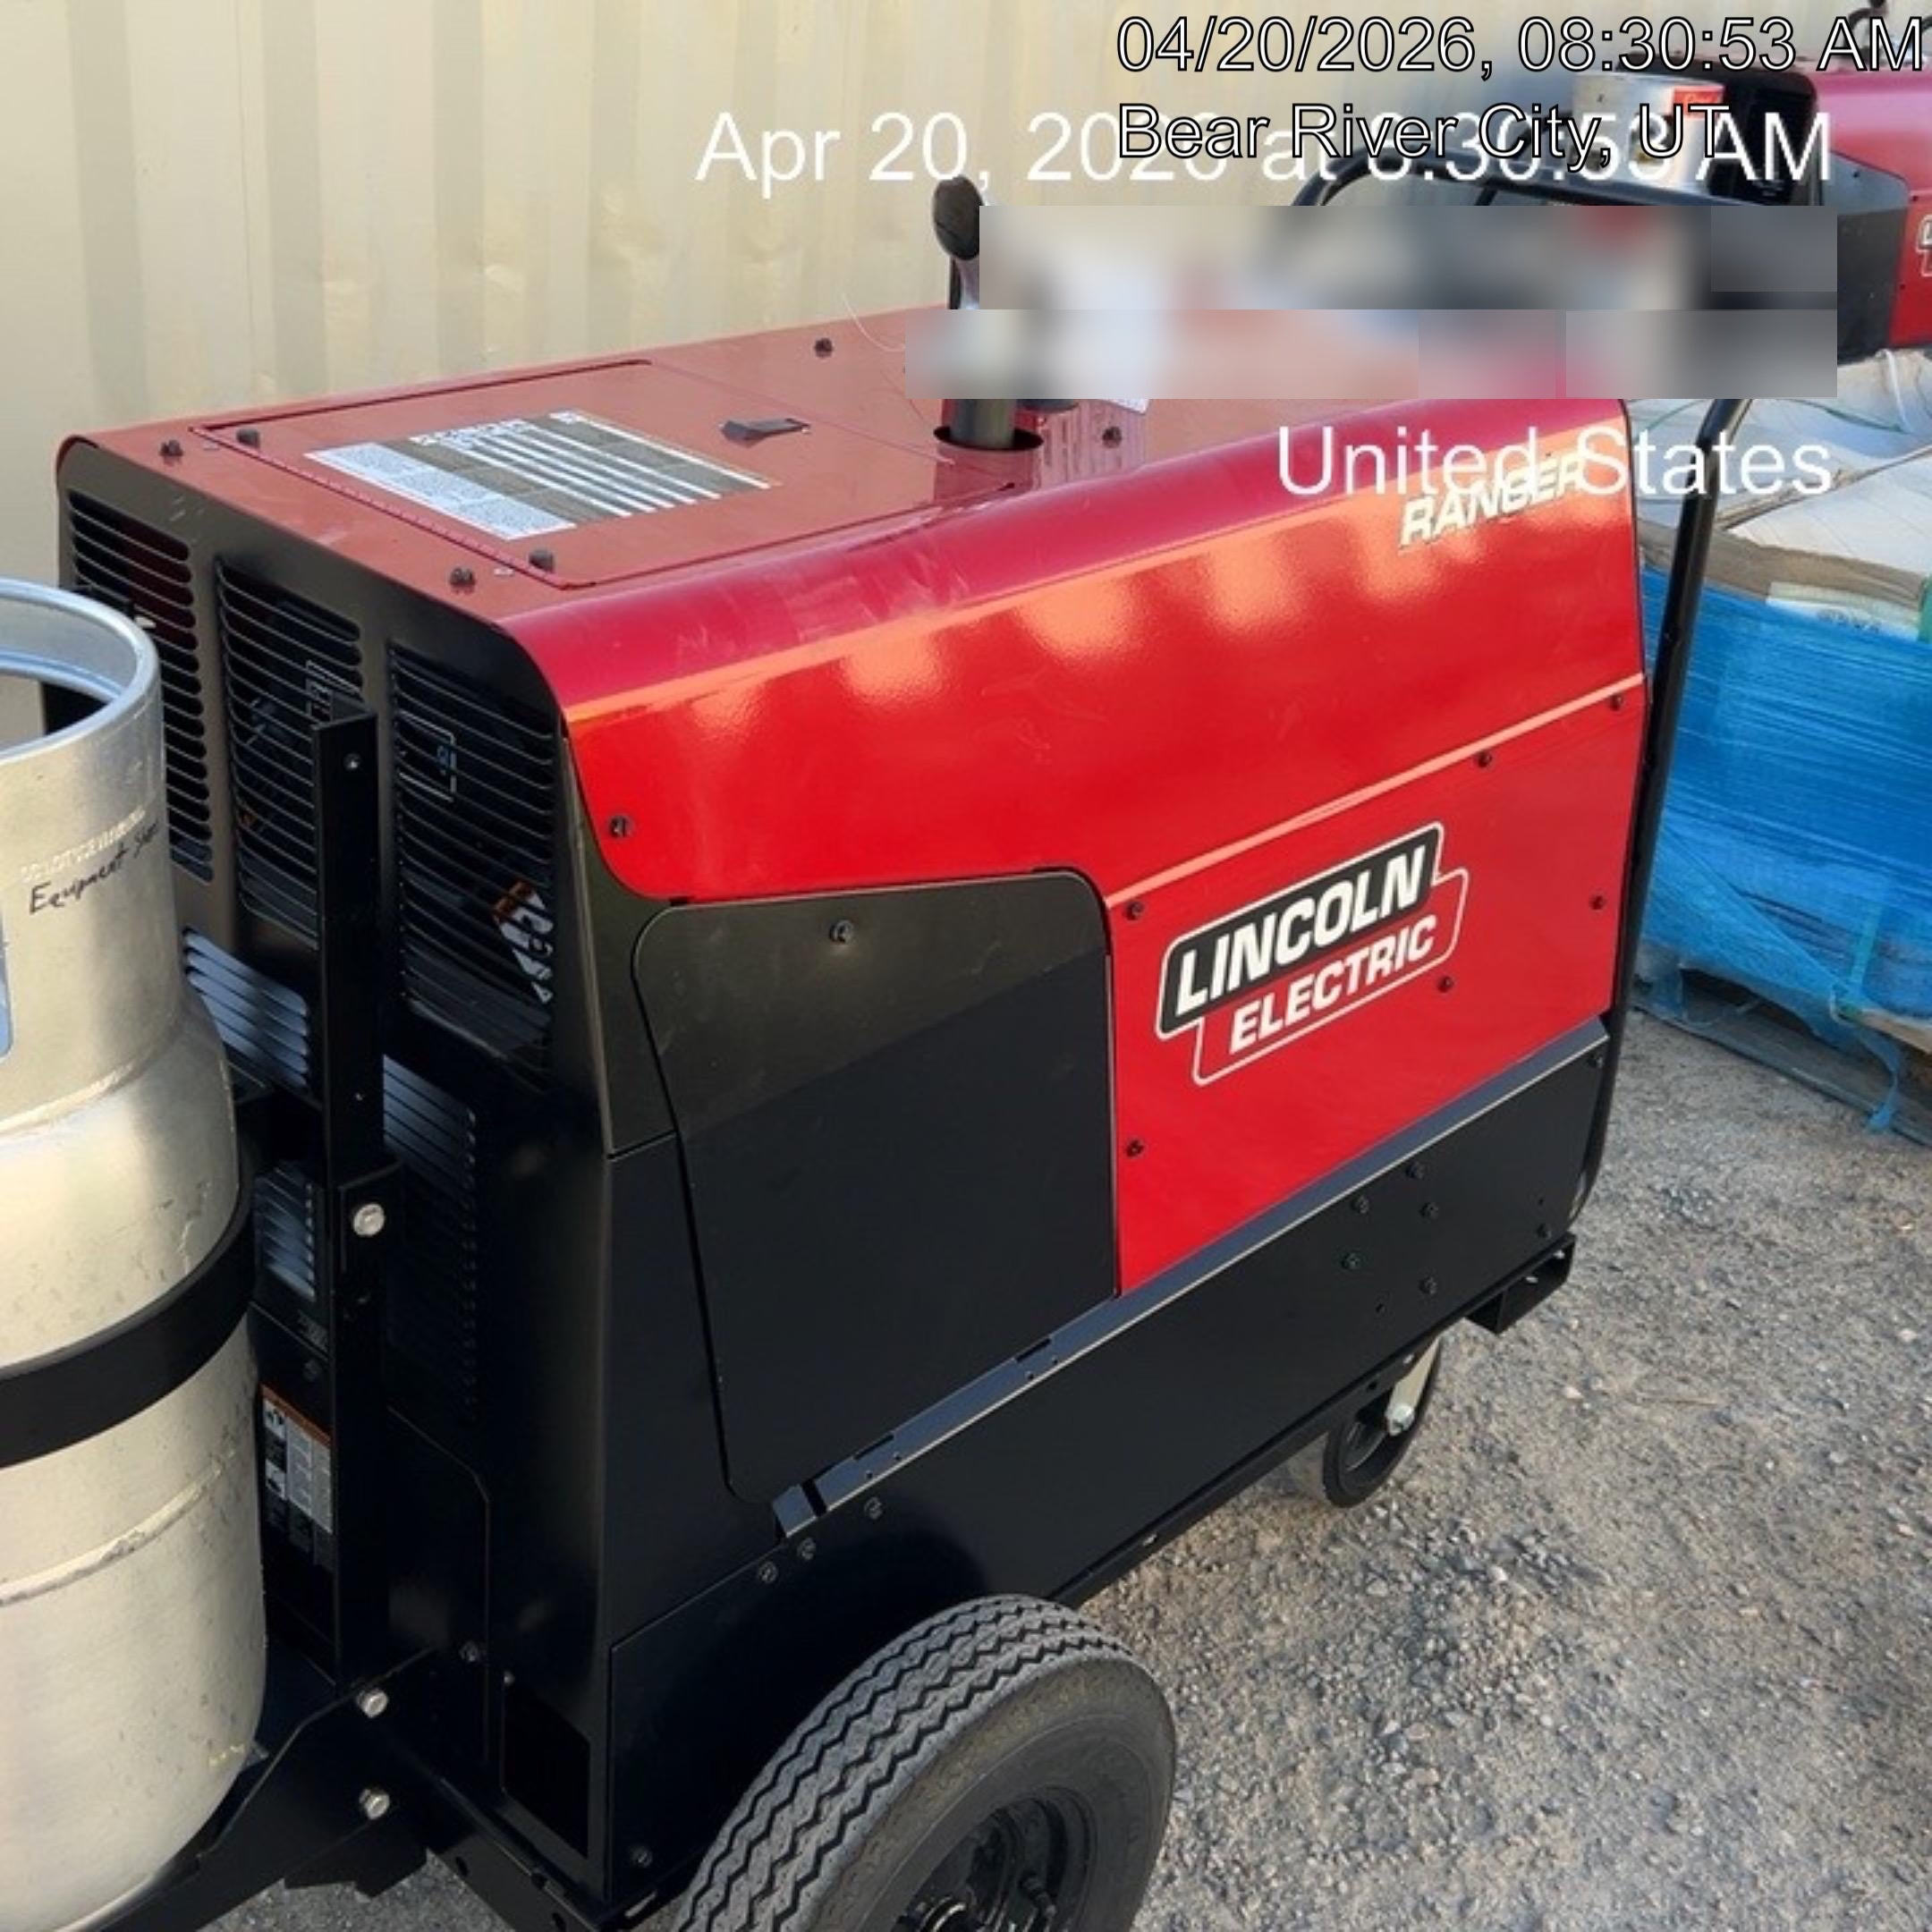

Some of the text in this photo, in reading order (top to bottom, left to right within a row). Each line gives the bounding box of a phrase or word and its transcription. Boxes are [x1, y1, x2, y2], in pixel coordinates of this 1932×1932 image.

[1398, 452, 1587, 549] RANGER
[1174, 844, 1427, 1017] LINCOLN
[1228, 914, 1437, 1055] ELECTRIC
